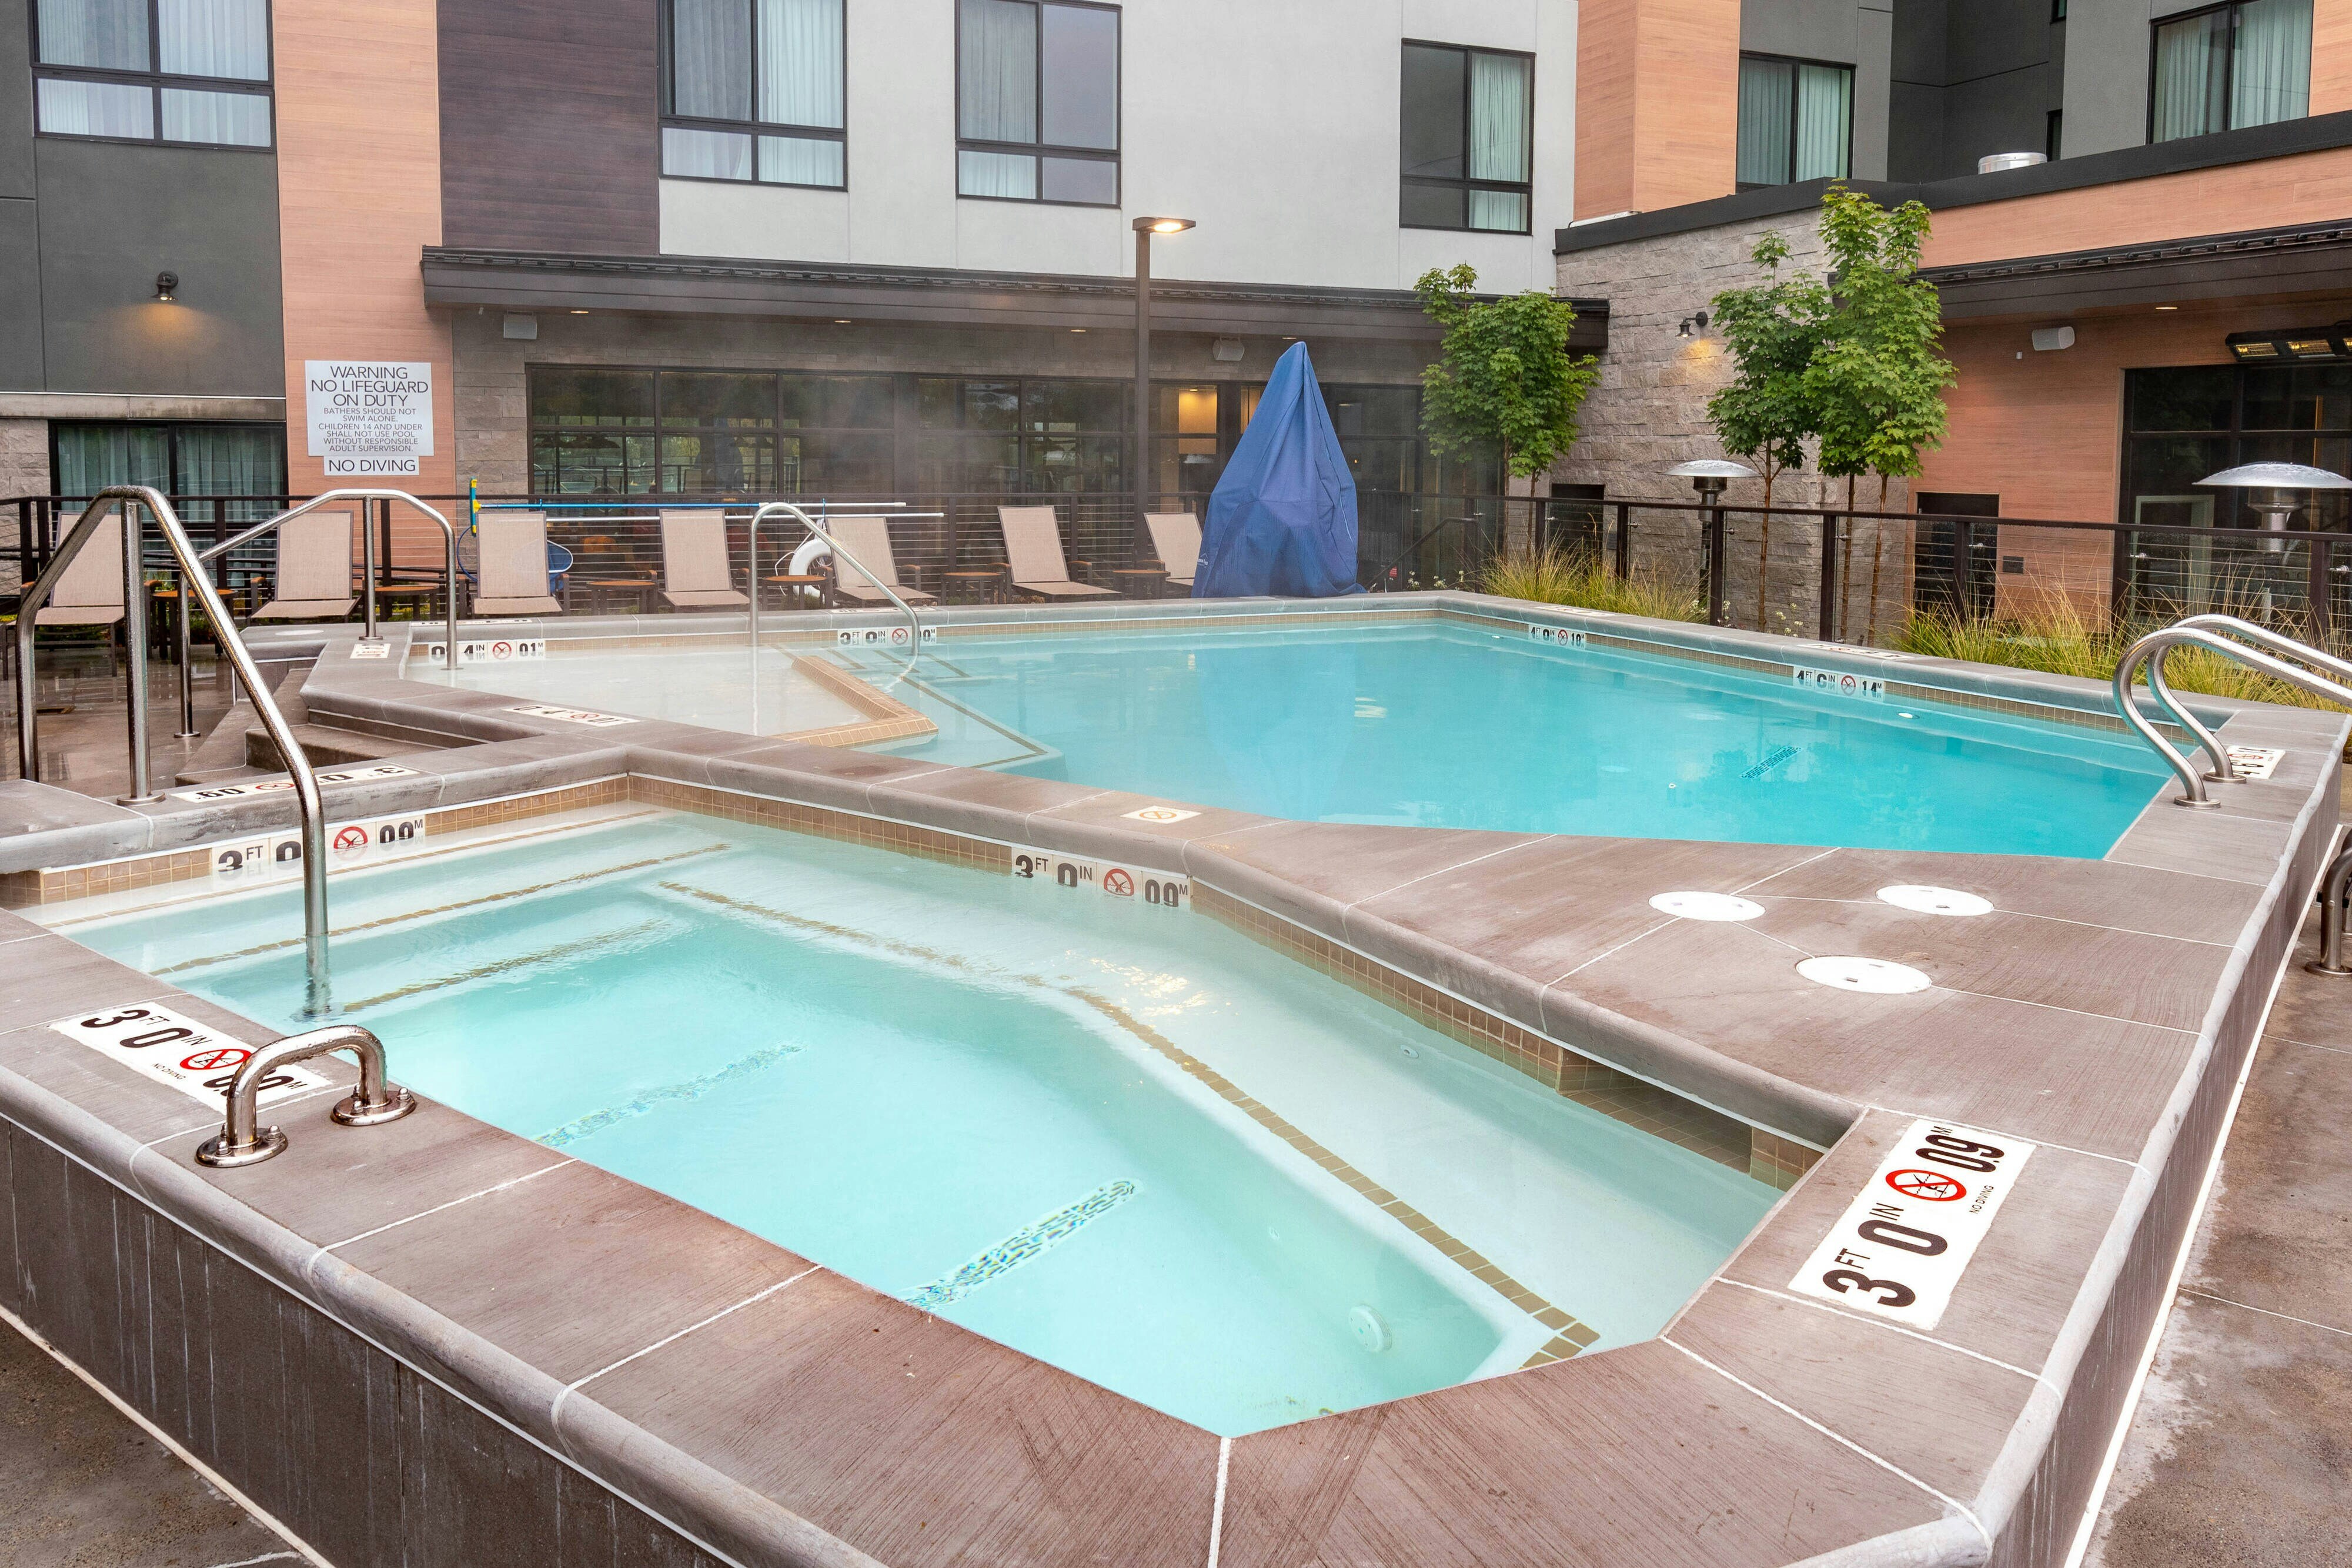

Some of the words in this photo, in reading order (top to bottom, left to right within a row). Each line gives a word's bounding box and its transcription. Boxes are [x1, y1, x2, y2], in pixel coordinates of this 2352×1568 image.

[330, 366, 407, 379] WARNING
[311, 380, 337, 392] NO
[343, 380, 429, 393] LIFEGUARD
[333, 394, 358, 406] ON
[365, 394, 408, 407] DUTY
[329, 459, 355, 472] NO
[360, 459, 415, 472] DIVING
[246, 845, 263, 860] FT
[414, 818, 423, 829] M
[1015, 854, 1034, 878] 3
[1035, 857, 1048, 872] FT
[1079, 865, 1093, 881] IN
[1178, 884, 1188, 895] M
[80, 1009, 151, 1028] 3
[139, 1015, 171, 1025] FT
[119, 1028, 193, 1048] 0
[181, 1035, 213, 1046] IN
[1930, 1125, 1953, 1135] M
[1968, 1204, 1982, 1214] NO
[1975, 1185, 1994, 1204] DIVING
[1868, 1202, 1905, 1221] IN
[1857, 1219, 1948, 1256] 0
[1833, 1248, 1871, 1269] FT
[1822, 1269, 1916, 1308] 3
